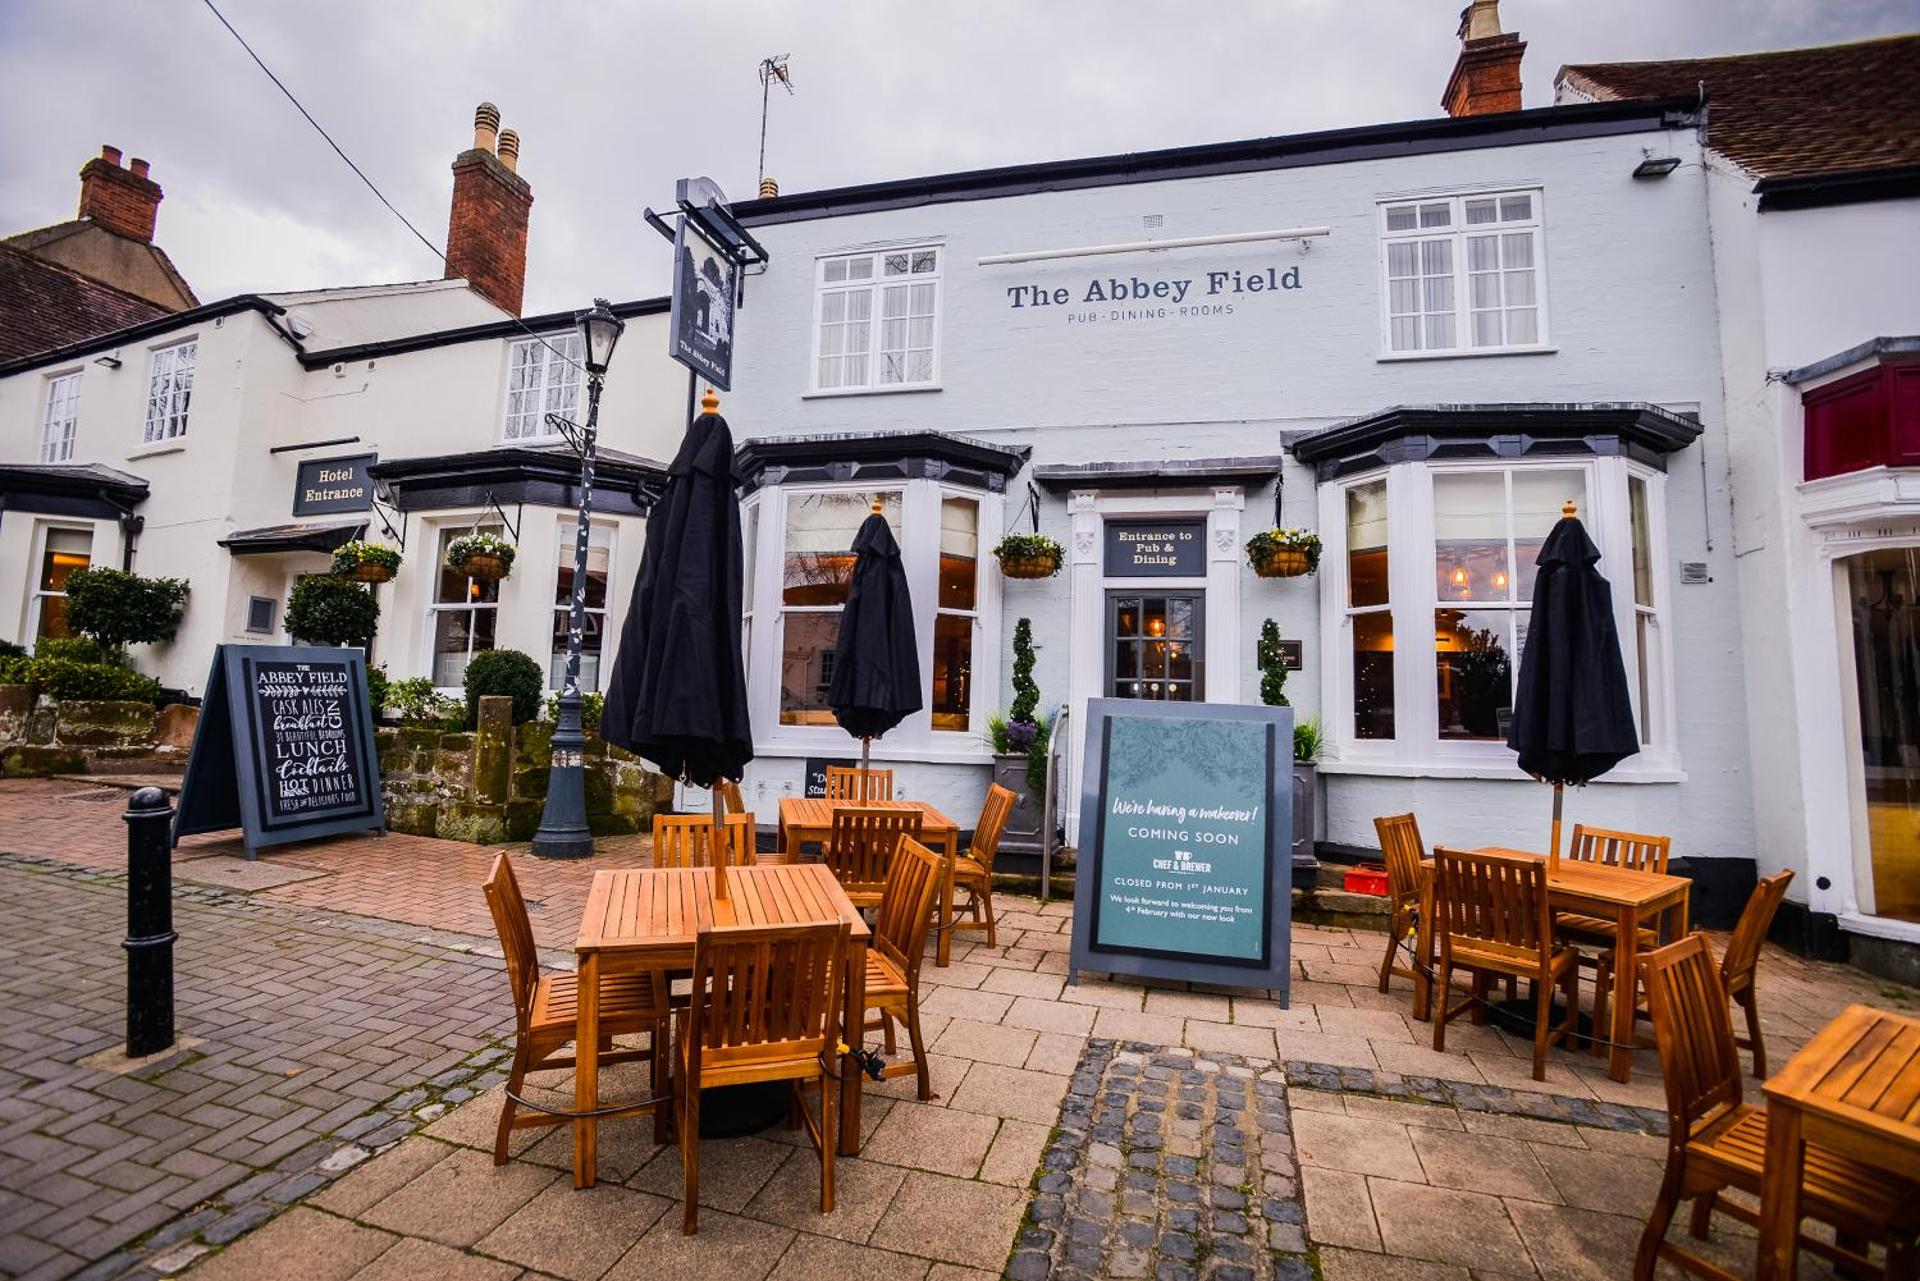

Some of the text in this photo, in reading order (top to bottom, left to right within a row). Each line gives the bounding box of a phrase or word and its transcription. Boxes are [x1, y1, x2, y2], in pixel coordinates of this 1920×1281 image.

[1007, 266, 1303, 308] The Abbey Field
[319, 467, 353, 483] Hotel
[305, 487, 363, 502] Entrance
[1118, 532, 1192, 541] Entrance to
[1136, 543, 1174, 553] Pub &
[1133, 555, 1177, 566] Dining
[258, 671, 348, 684] ABBEY FIELD
[272, 699, 325, 715] CASK ALES
[326, 700, 342, 729] GIN
[276, 739, 347, 759] LUNCH
[275, 754, 349, 779] Cocktails
[280, 773, 354, 793] HOT DINNER
[1112, 797, 1145, 815] We're
[1146, 799, 1186, 824] having
[1188, 808, 1199, 818] a
[1128, 827, 1239, 845] COMING SOON
[1153, 858, 1211, 873] CHEF & BREWER
[1114, 877, 1152, 888] CLOSED
[1156, 881, 1183, 890] FROM
[1202, 885, 1249, 896] JANUARY
[1110, 895, 1122, 903] We
[1123, 896, 1140, 904] look
[1141, 897, 1169, 907] forward
[1180, 901, 1218, 913] welcoming
[1220, 905, 1233, 913] you
[1235, 905, 1253, 914] from
[1137, 906, 1168, 918] February
[1169, 910, 1186, 919] with
[1219, 914, 1236, 922] look
